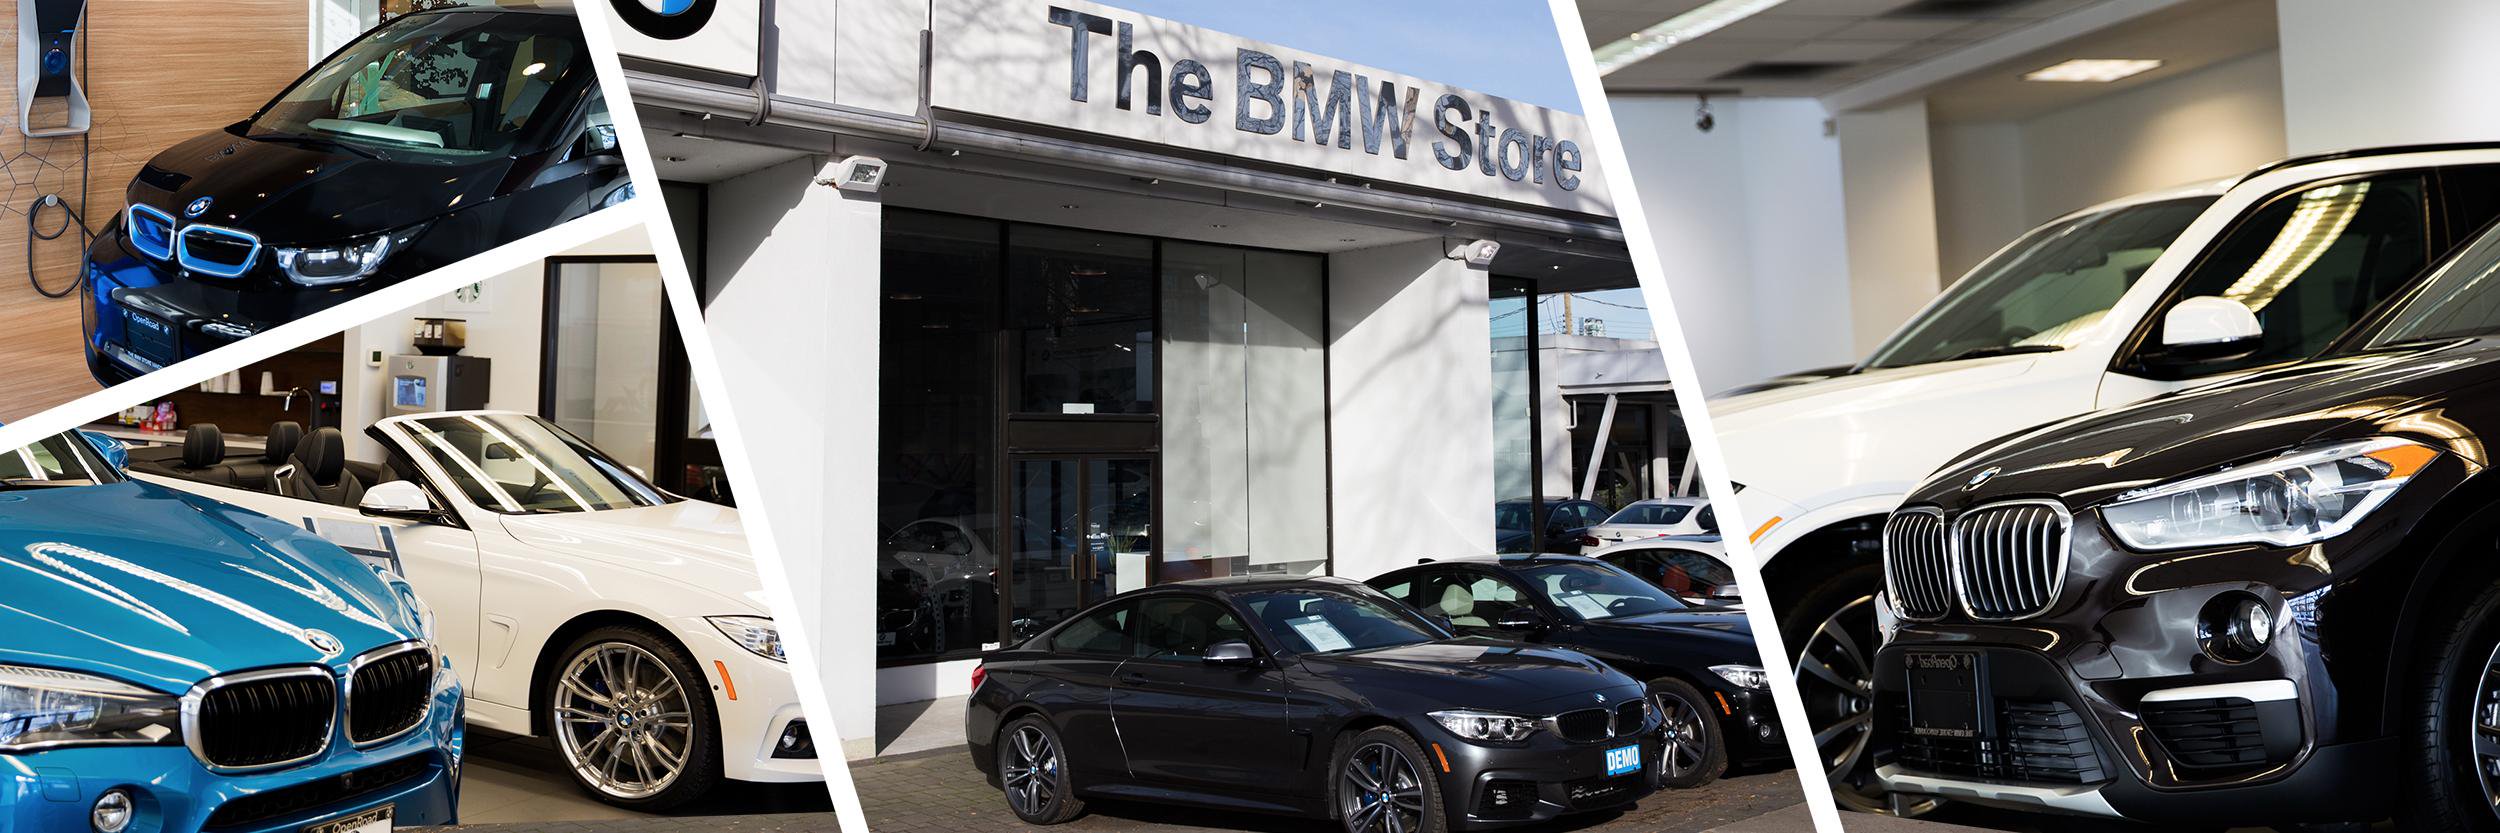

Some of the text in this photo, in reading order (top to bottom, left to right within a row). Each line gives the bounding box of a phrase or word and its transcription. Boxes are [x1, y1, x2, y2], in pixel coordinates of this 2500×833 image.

[1048, 5, 1584, 192] The BMW Store
[131, 312, 160, 331] OpenRoad
[1607, 746, 1639, 770] DEMO
[333, 811, 378, 833] OpenRoad
